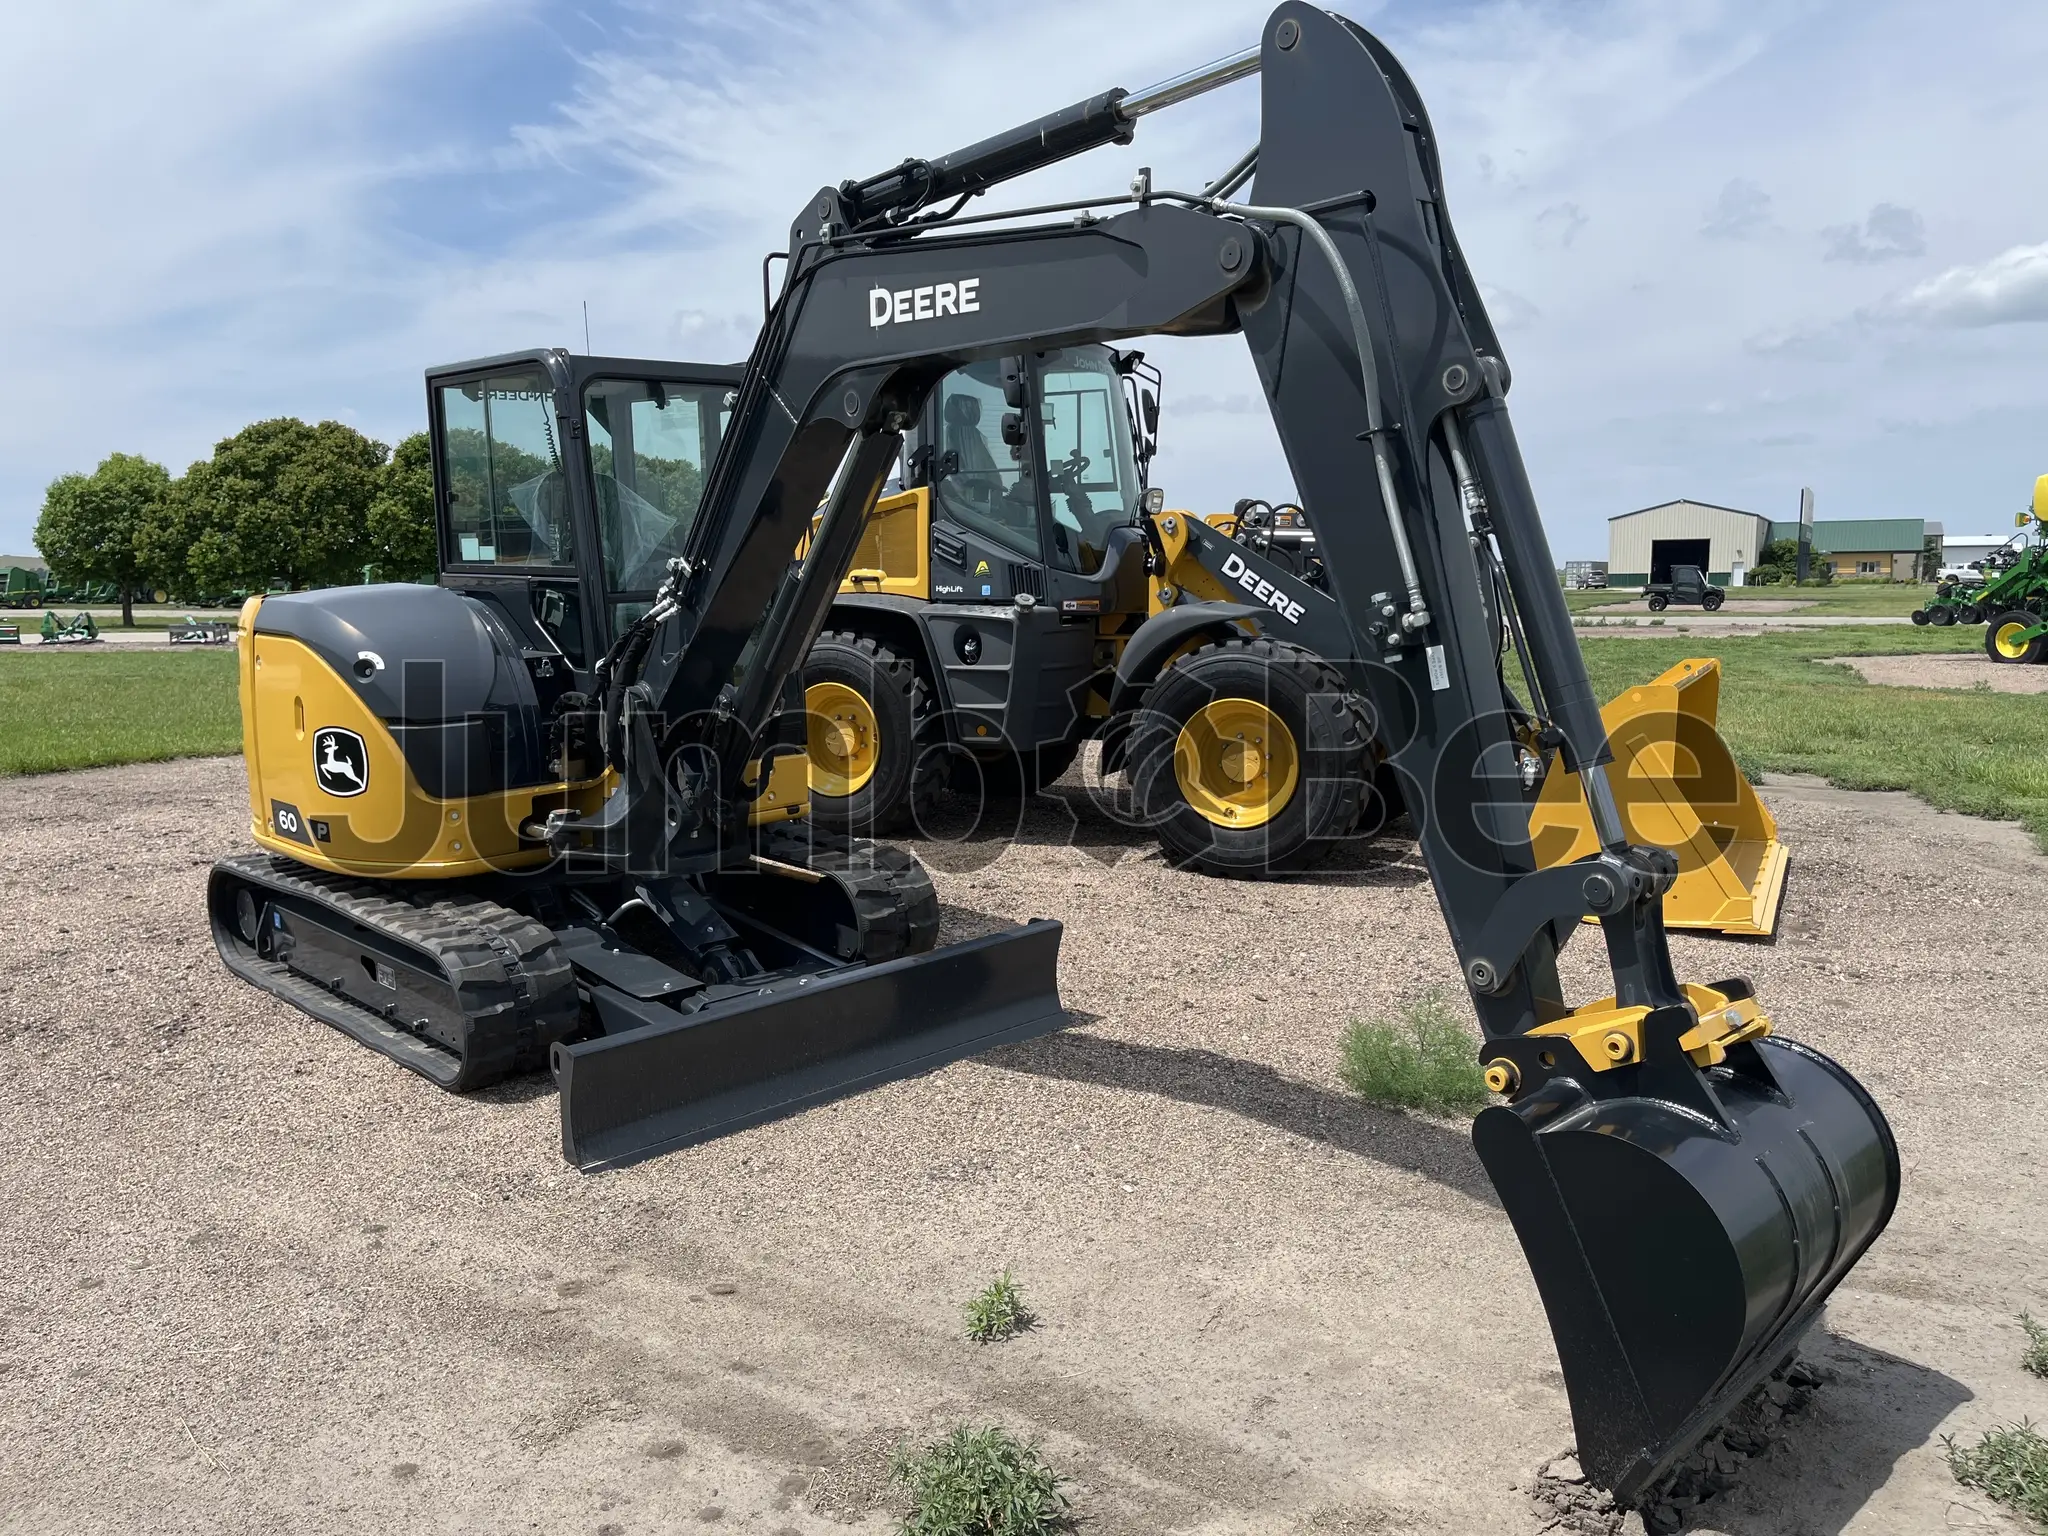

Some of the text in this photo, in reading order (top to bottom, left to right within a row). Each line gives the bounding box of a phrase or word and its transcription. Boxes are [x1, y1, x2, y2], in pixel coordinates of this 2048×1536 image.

[869, 277, 980, 328] DEERE
[1073, 356, 1098, 371] JOHN
[1220, 552, 1306, 625] DEERE
[278, 809, 328, 840] 60 P
